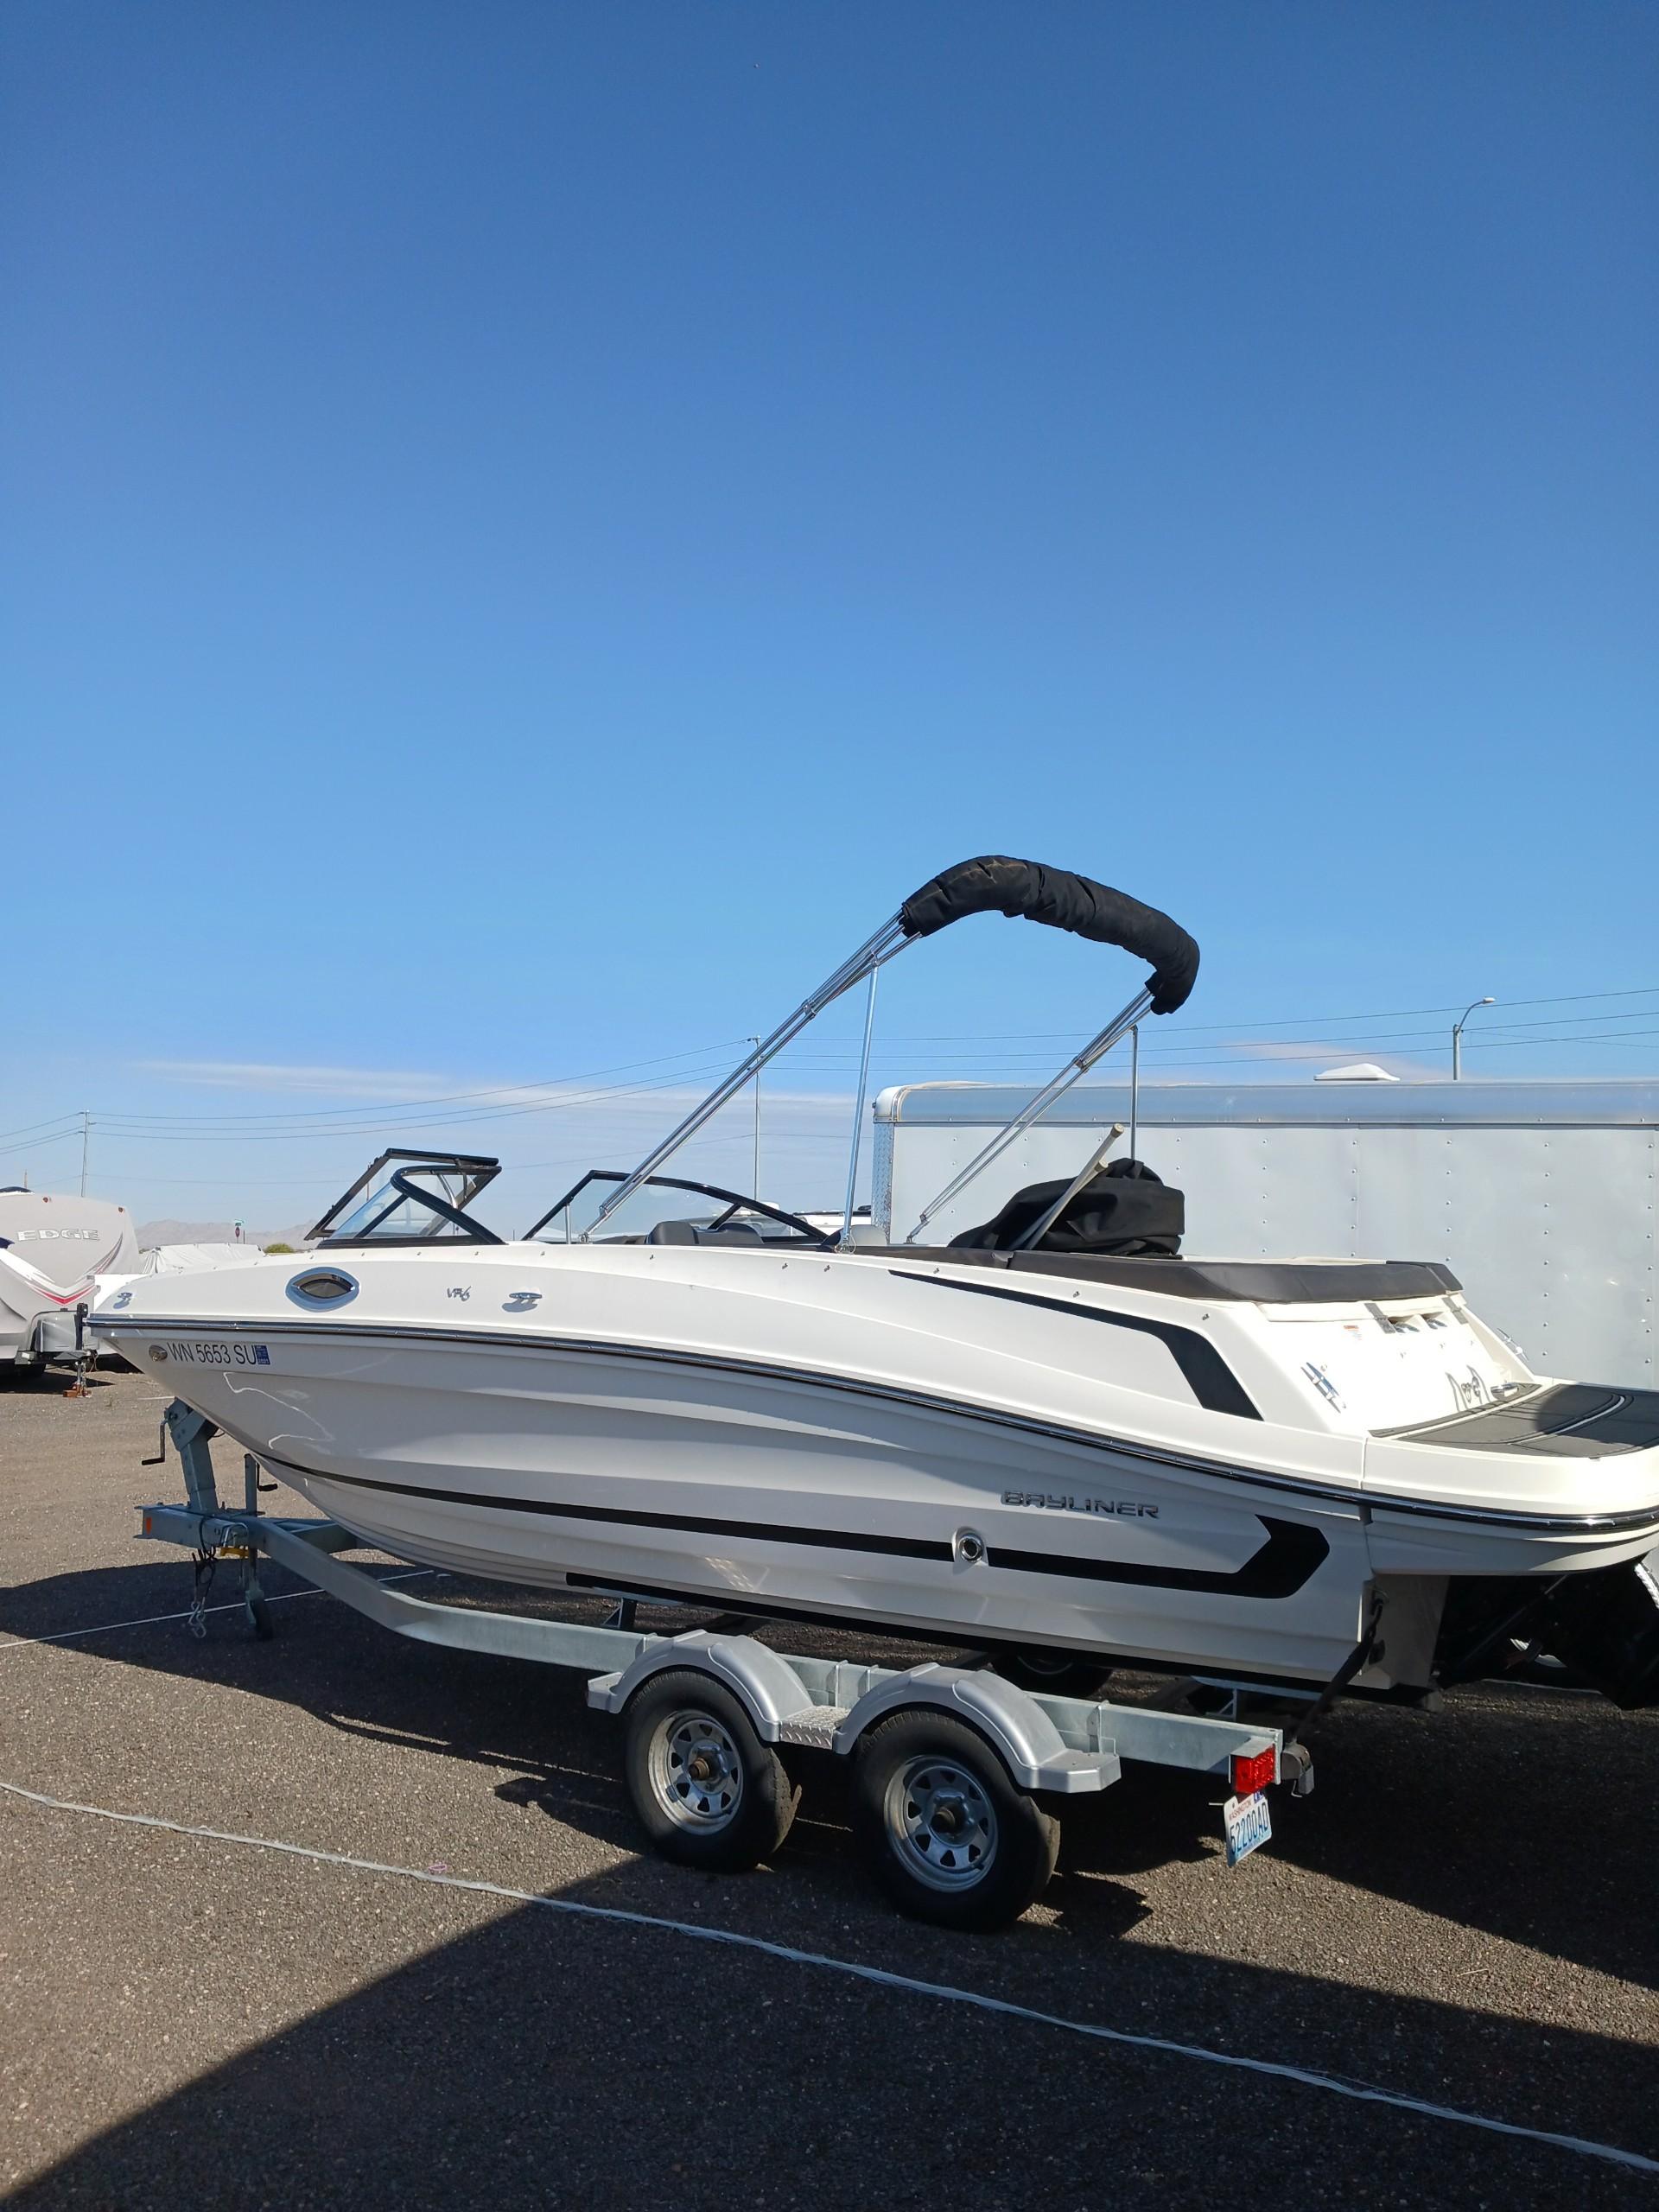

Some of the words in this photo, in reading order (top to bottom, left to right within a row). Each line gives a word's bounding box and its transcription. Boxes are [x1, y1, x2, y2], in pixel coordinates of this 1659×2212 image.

[17, 1229, 100, 1242] EDGE
[167, 1343, 194, 1362] WN
[195, 1344, 231, 1363] 5653
[233, 1344, 257, 1365] SU
[1001, 1491, 1160, 1519] BAYLINER
